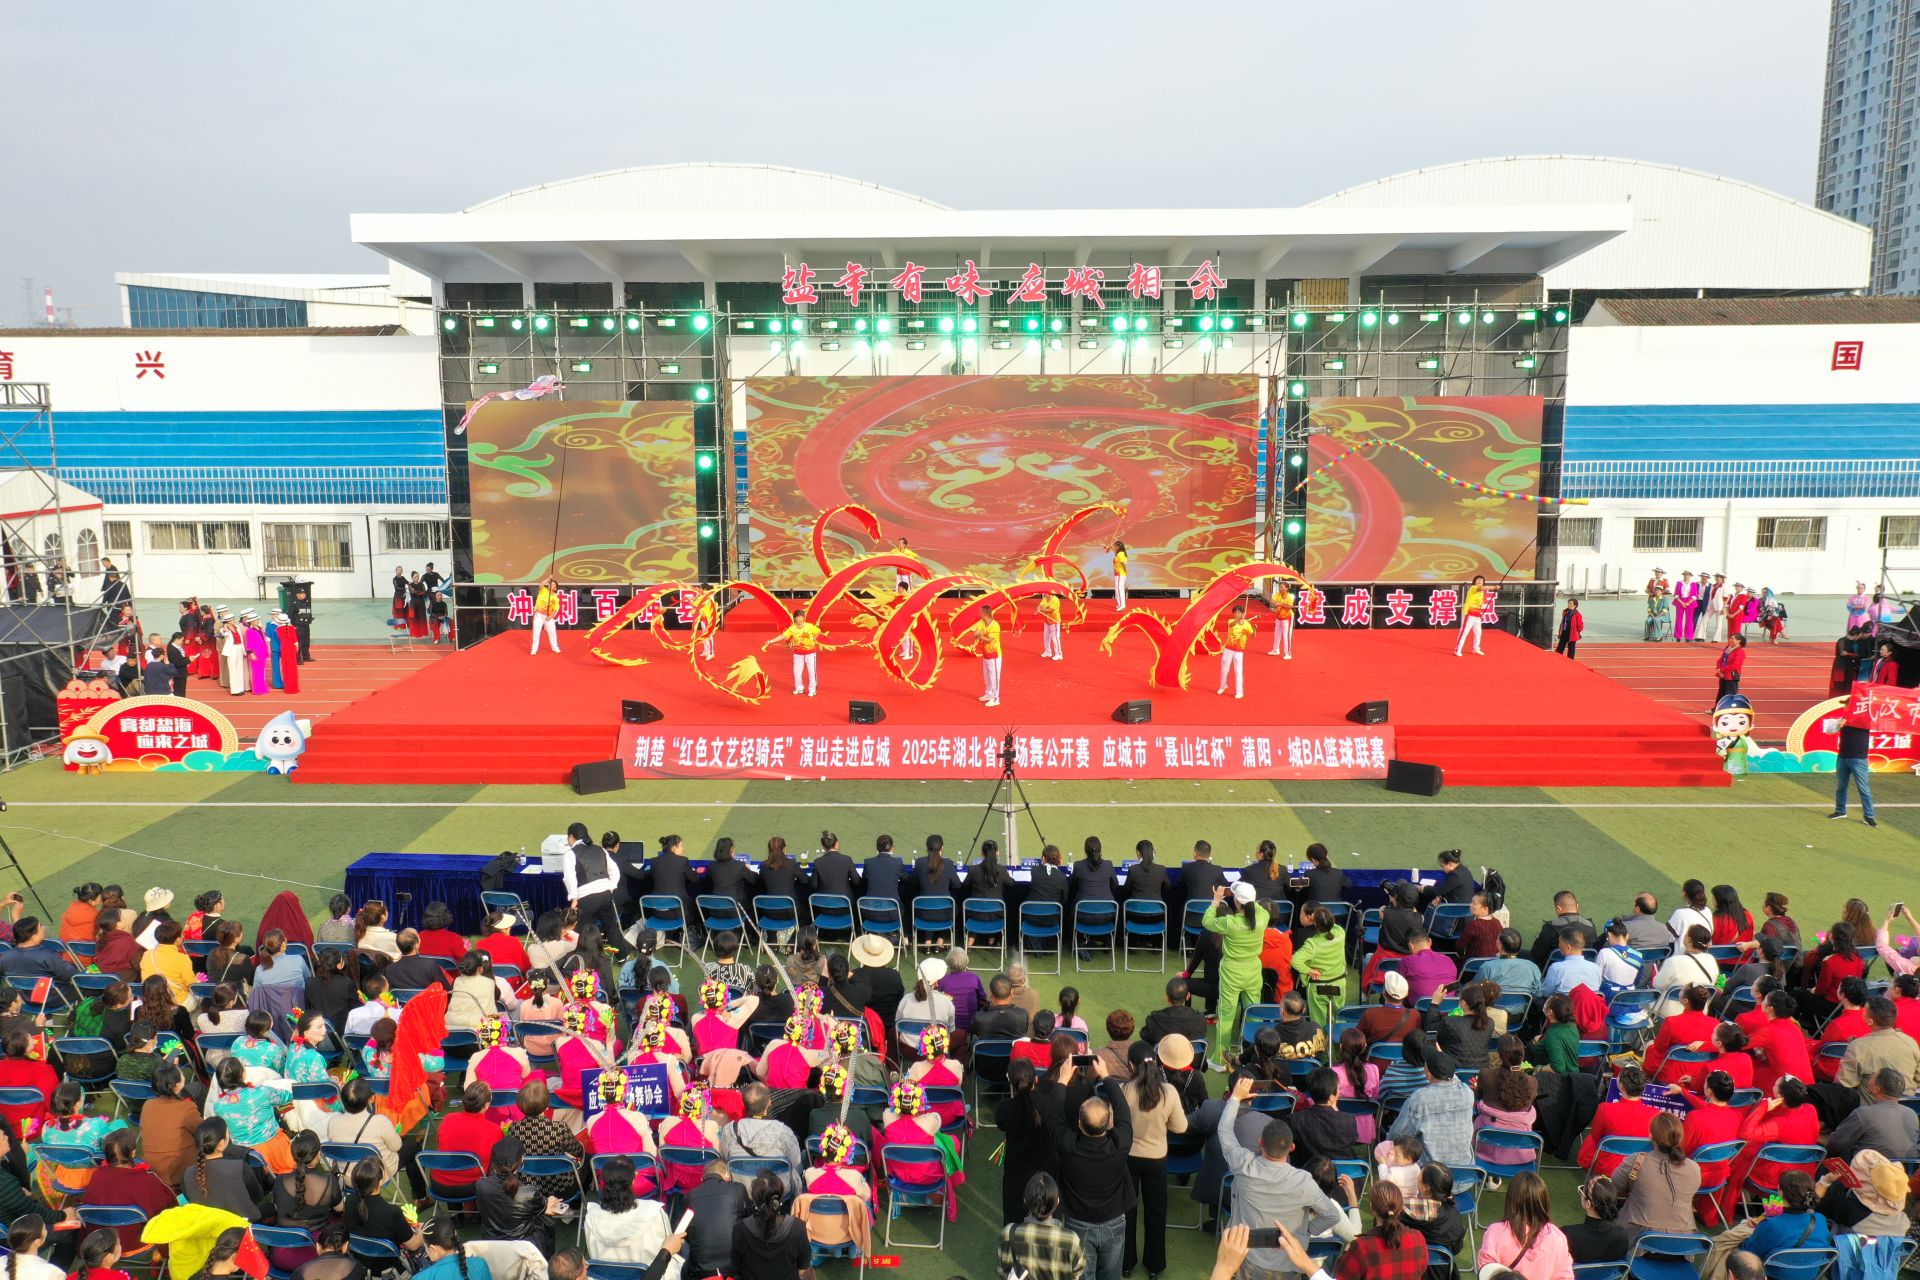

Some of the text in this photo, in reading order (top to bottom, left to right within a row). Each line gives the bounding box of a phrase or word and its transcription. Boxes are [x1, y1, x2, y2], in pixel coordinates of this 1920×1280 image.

[135, 350, 165, 379] 兴
[1831, 341, 1864, 371] 国
[136, 733, 209, 749] 应来之城
